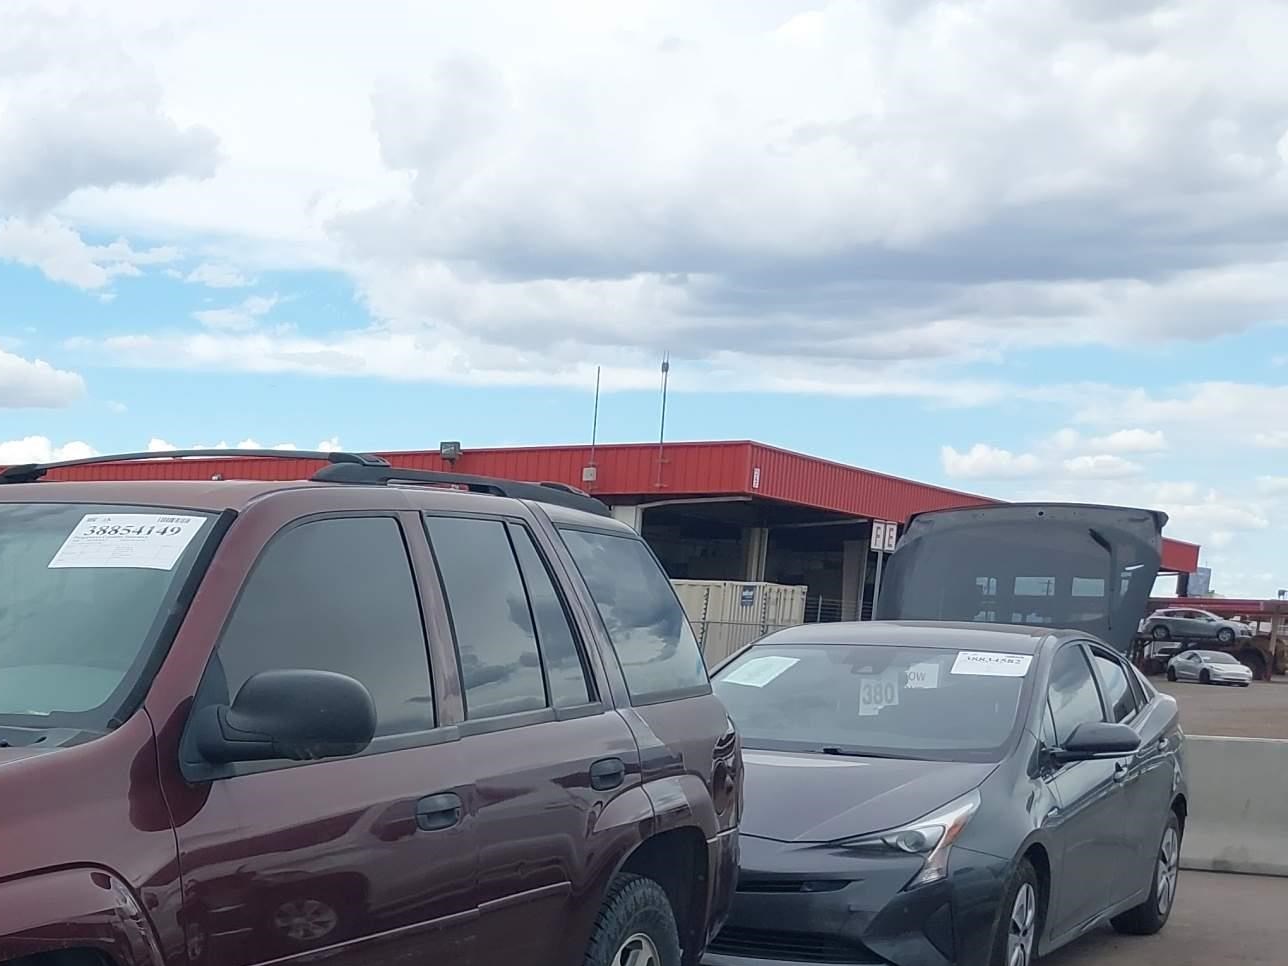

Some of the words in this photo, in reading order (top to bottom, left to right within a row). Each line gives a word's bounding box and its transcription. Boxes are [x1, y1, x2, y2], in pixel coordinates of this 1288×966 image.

[83, 525, 182, 536] 38854149
[874, 526, 881, 547] F
[888, 527, 894, 548] E
[862, 683, 895, 705] 380
